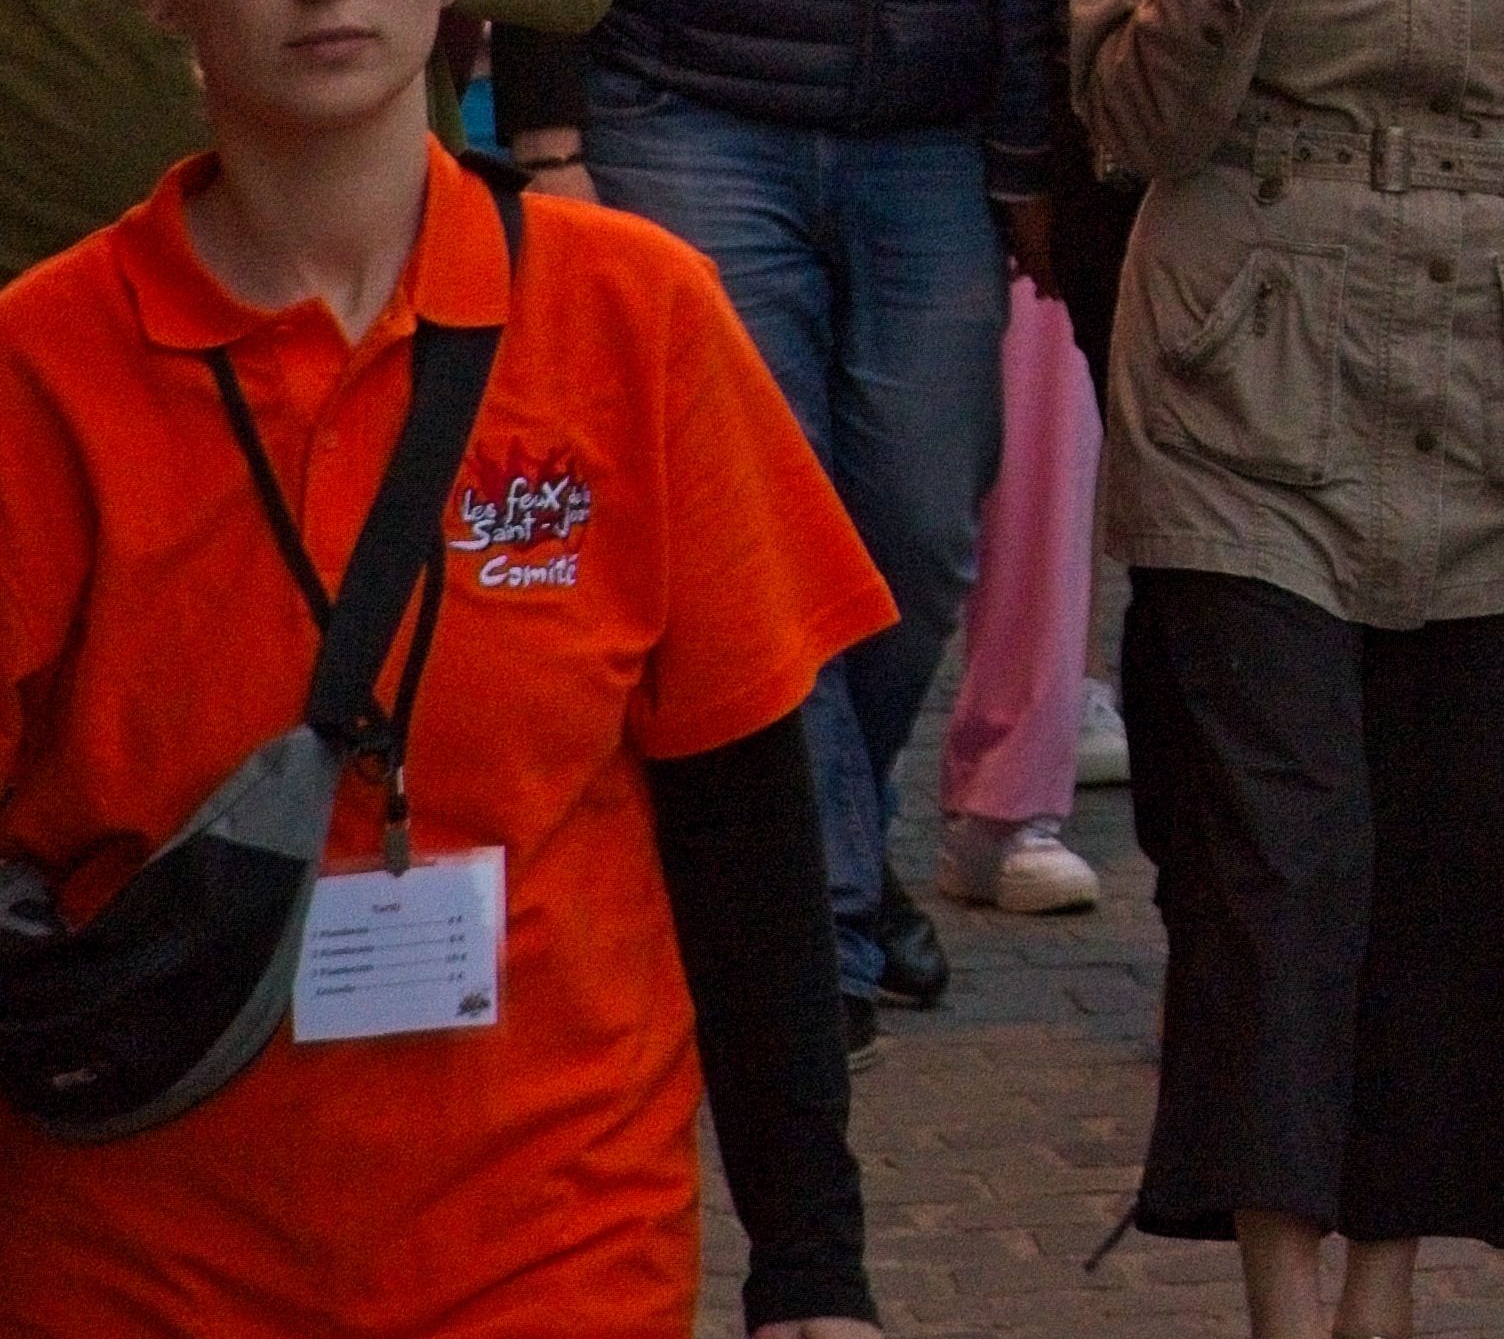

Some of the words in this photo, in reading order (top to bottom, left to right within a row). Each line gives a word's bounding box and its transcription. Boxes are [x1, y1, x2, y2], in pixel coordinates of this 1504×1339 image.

[462, 488, 498, 523] Les
[505, 476, 570, 524] feux
[480, 553, 579, 588] Comité
